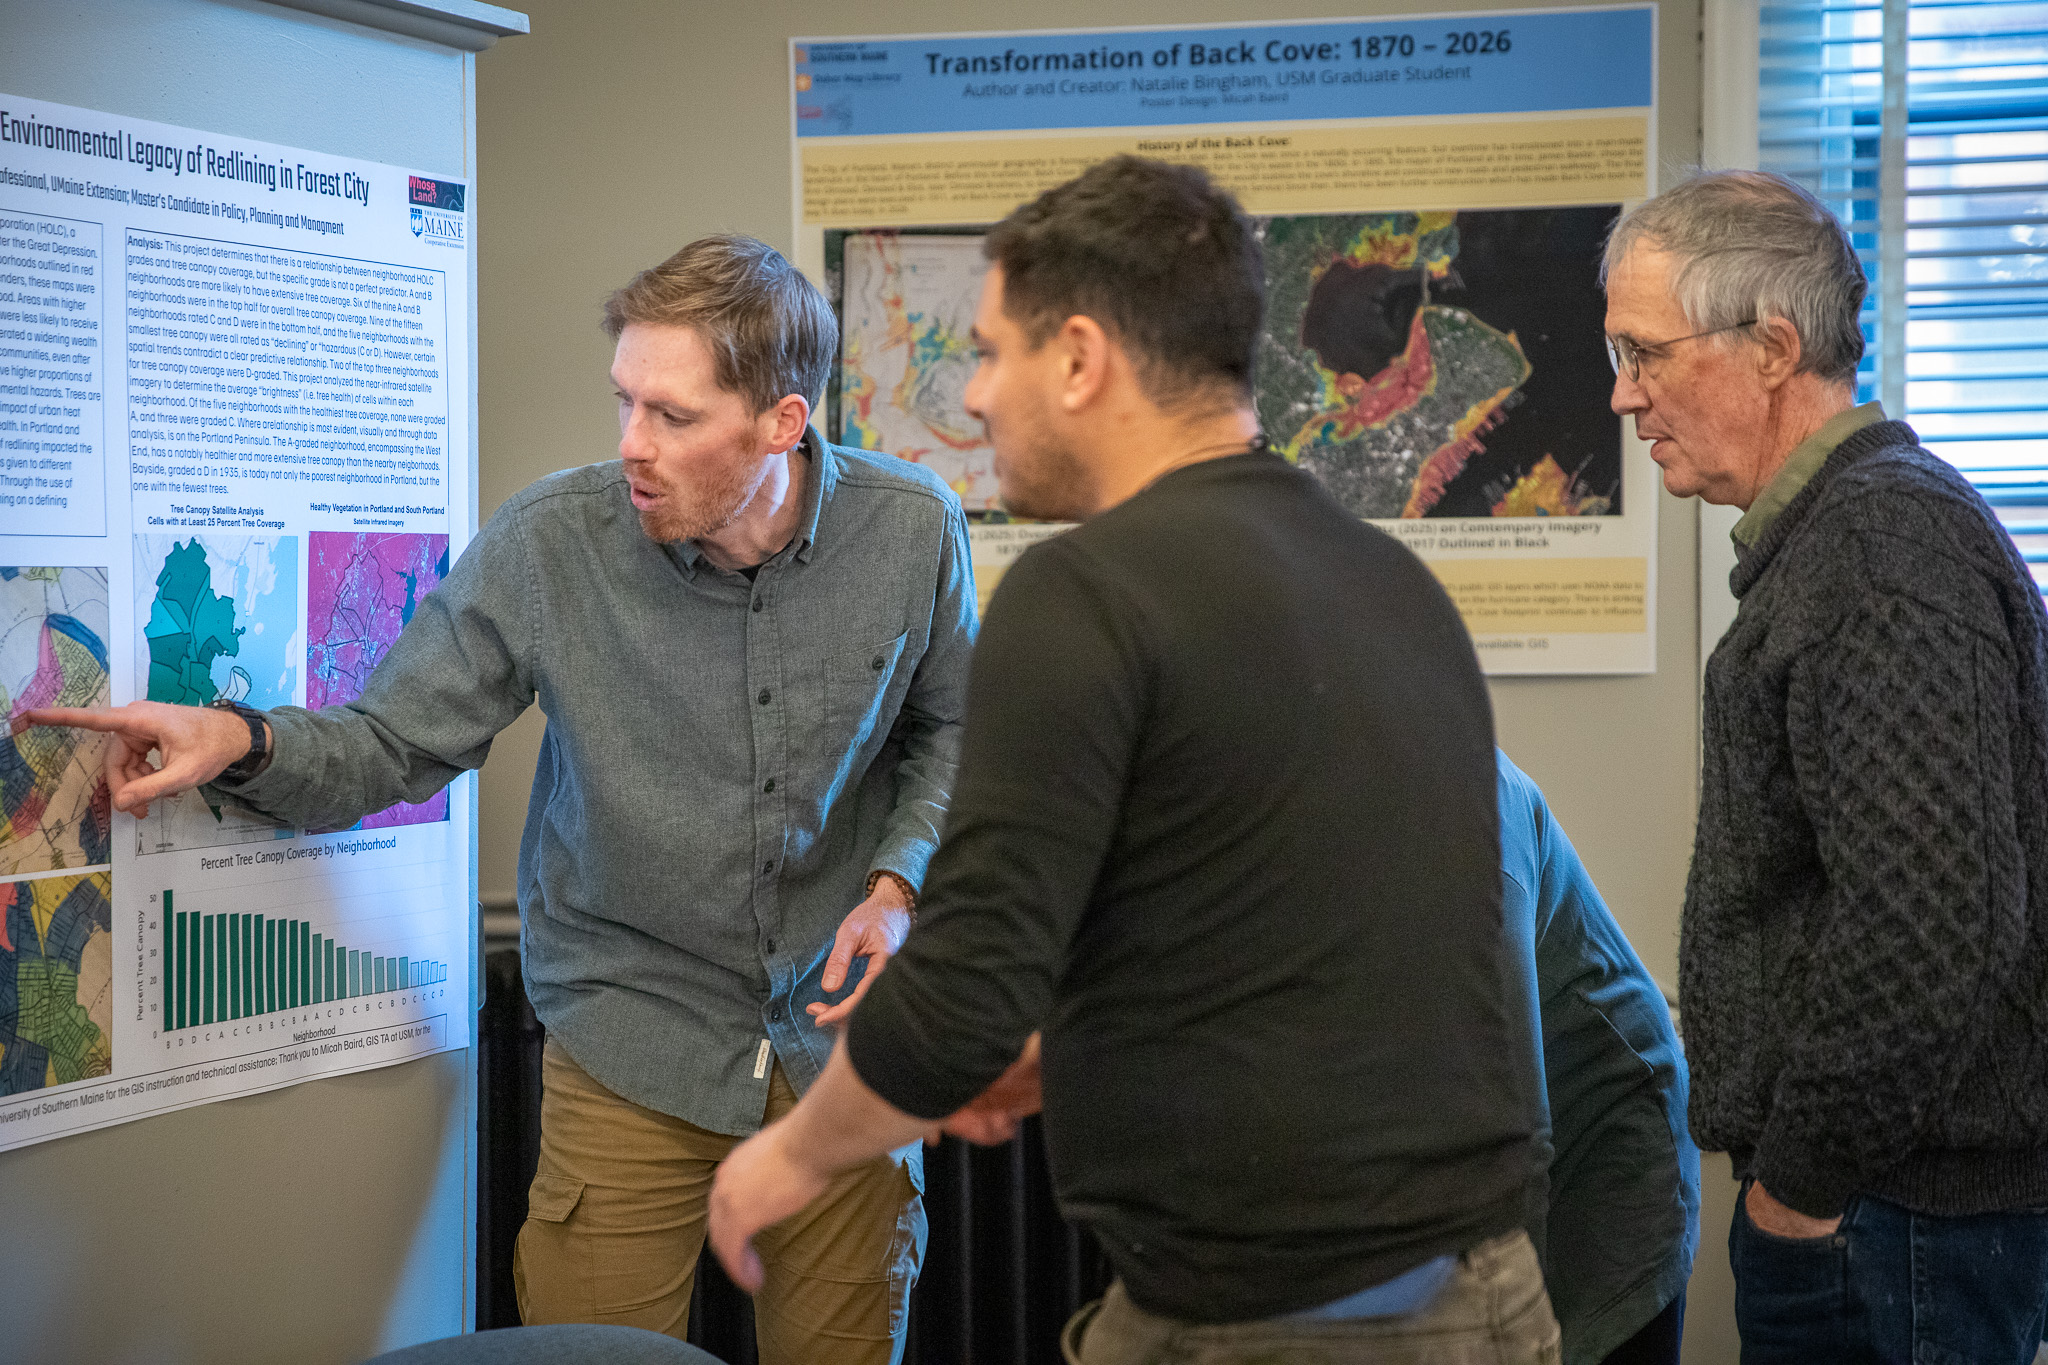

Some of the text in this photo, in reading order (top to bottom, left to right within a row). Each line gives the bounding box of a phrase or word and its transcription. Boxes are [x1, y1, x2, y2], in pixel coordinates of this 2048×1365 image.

[926, 47, 1143, 76] Transformation
[1152, 44, 1180, 67] of
[1189, 41, 1255, 65] Back
[1264, 40, 1340, 62] Cove:
[1351, 34, 1415, 58] 1870
[1445, 30, 1511, 55] 2026
[962, 82, 1019, 98] Author
[1022, 80, 1055, 95] and
[1130, 75, 1189, 91] Natalie
[1193, 73, 1270, 92] Bingham,
[1276, 70, 1315, 86] USM
[1320, 68, 1400, 84] Graduate
[1404, 65, 1471, 81] Student
[0, 112, 369, 206] Environmental Legacy of Redlining in Forest City
[410, 176, 436, 191] Whose
[50, 174, 84, 194] UMaine
[86, 179, 129, 204] Extension;
[167, 192, 210, 214] Candidate
[211, 199, 219, 215] in
[221, 201, 247, 222] Policy,
[249, 205, 283, 228] Planning
[284, 212, 299, 228] and
[300, 213, 344, 234] Managment
[413, 188, 437, 203] Land?
[36, 222, 69, 238] (HOLC),
[69, 229, 75, 237] a
[425, 217, 463, 238] MAINE
[127, 235, 433, 285] Analysis: This project determines that there is a relationship between neighborhood HOLC
[127, 254, 432, 300] grades and tree canopy coverage, but the specific grade is not a perfect predictor. A and B
[21, 311, 37, 323] less
[39, 313, 59, 328] likely
[60, 316, 68, 326] to
[70, 318, 98, 329] receive
[170, 504, 264, 517] Tree Canopy Satellite Analysis
[310, 502, 444, 514] Healthy Vegetation in Portland and South Portland
[147, 516, 285, 529] Cells with at Least 25 Percent Tree Coverage
[387, 519, 404, 527] Imagery
[201, 835, 396, 869] Percent Tree Canopy Coverage by Neighborhood
[137, 910, 145, 950] Canopy
[150, 949, 156, 957] 30
[150, 976, 156, 984] 20
[293, 1025, 335, 1042] Neighborhood
[32, 1103, 40, 1116] of
[41, 1098, 78, 1114] Southern
[79, 1091, 104, 1105] Maine
[105, 1088, 116, 1100] for
[117, 1085, 130, 1097] the
[130, 1081, 144, 1094] GIS
[145, 1074, 184, 1091] instruction
[185, 1069, 200, 1083] and
[201, 1061, 237, 1079] technical
[238, 1056, 277, 1071] assistance;
[278, 1049, 298, 1063] Thank
[298, 1049, 310, 1061] you
[311, 1046, 318, 1056] to
[319, 1040, 342, 1054] Micah
[343, 1036, 364, 1050] Baird,
[365, 1033, 379, 1045] GIS
[379, 1031, 389, 1042] TA
[390, 1030, 397, 1040] at
[398, 1027, 413, 1039] USM,
[414, 1026, 423, 1036] for
[422, 1024, 430, 1034] the
